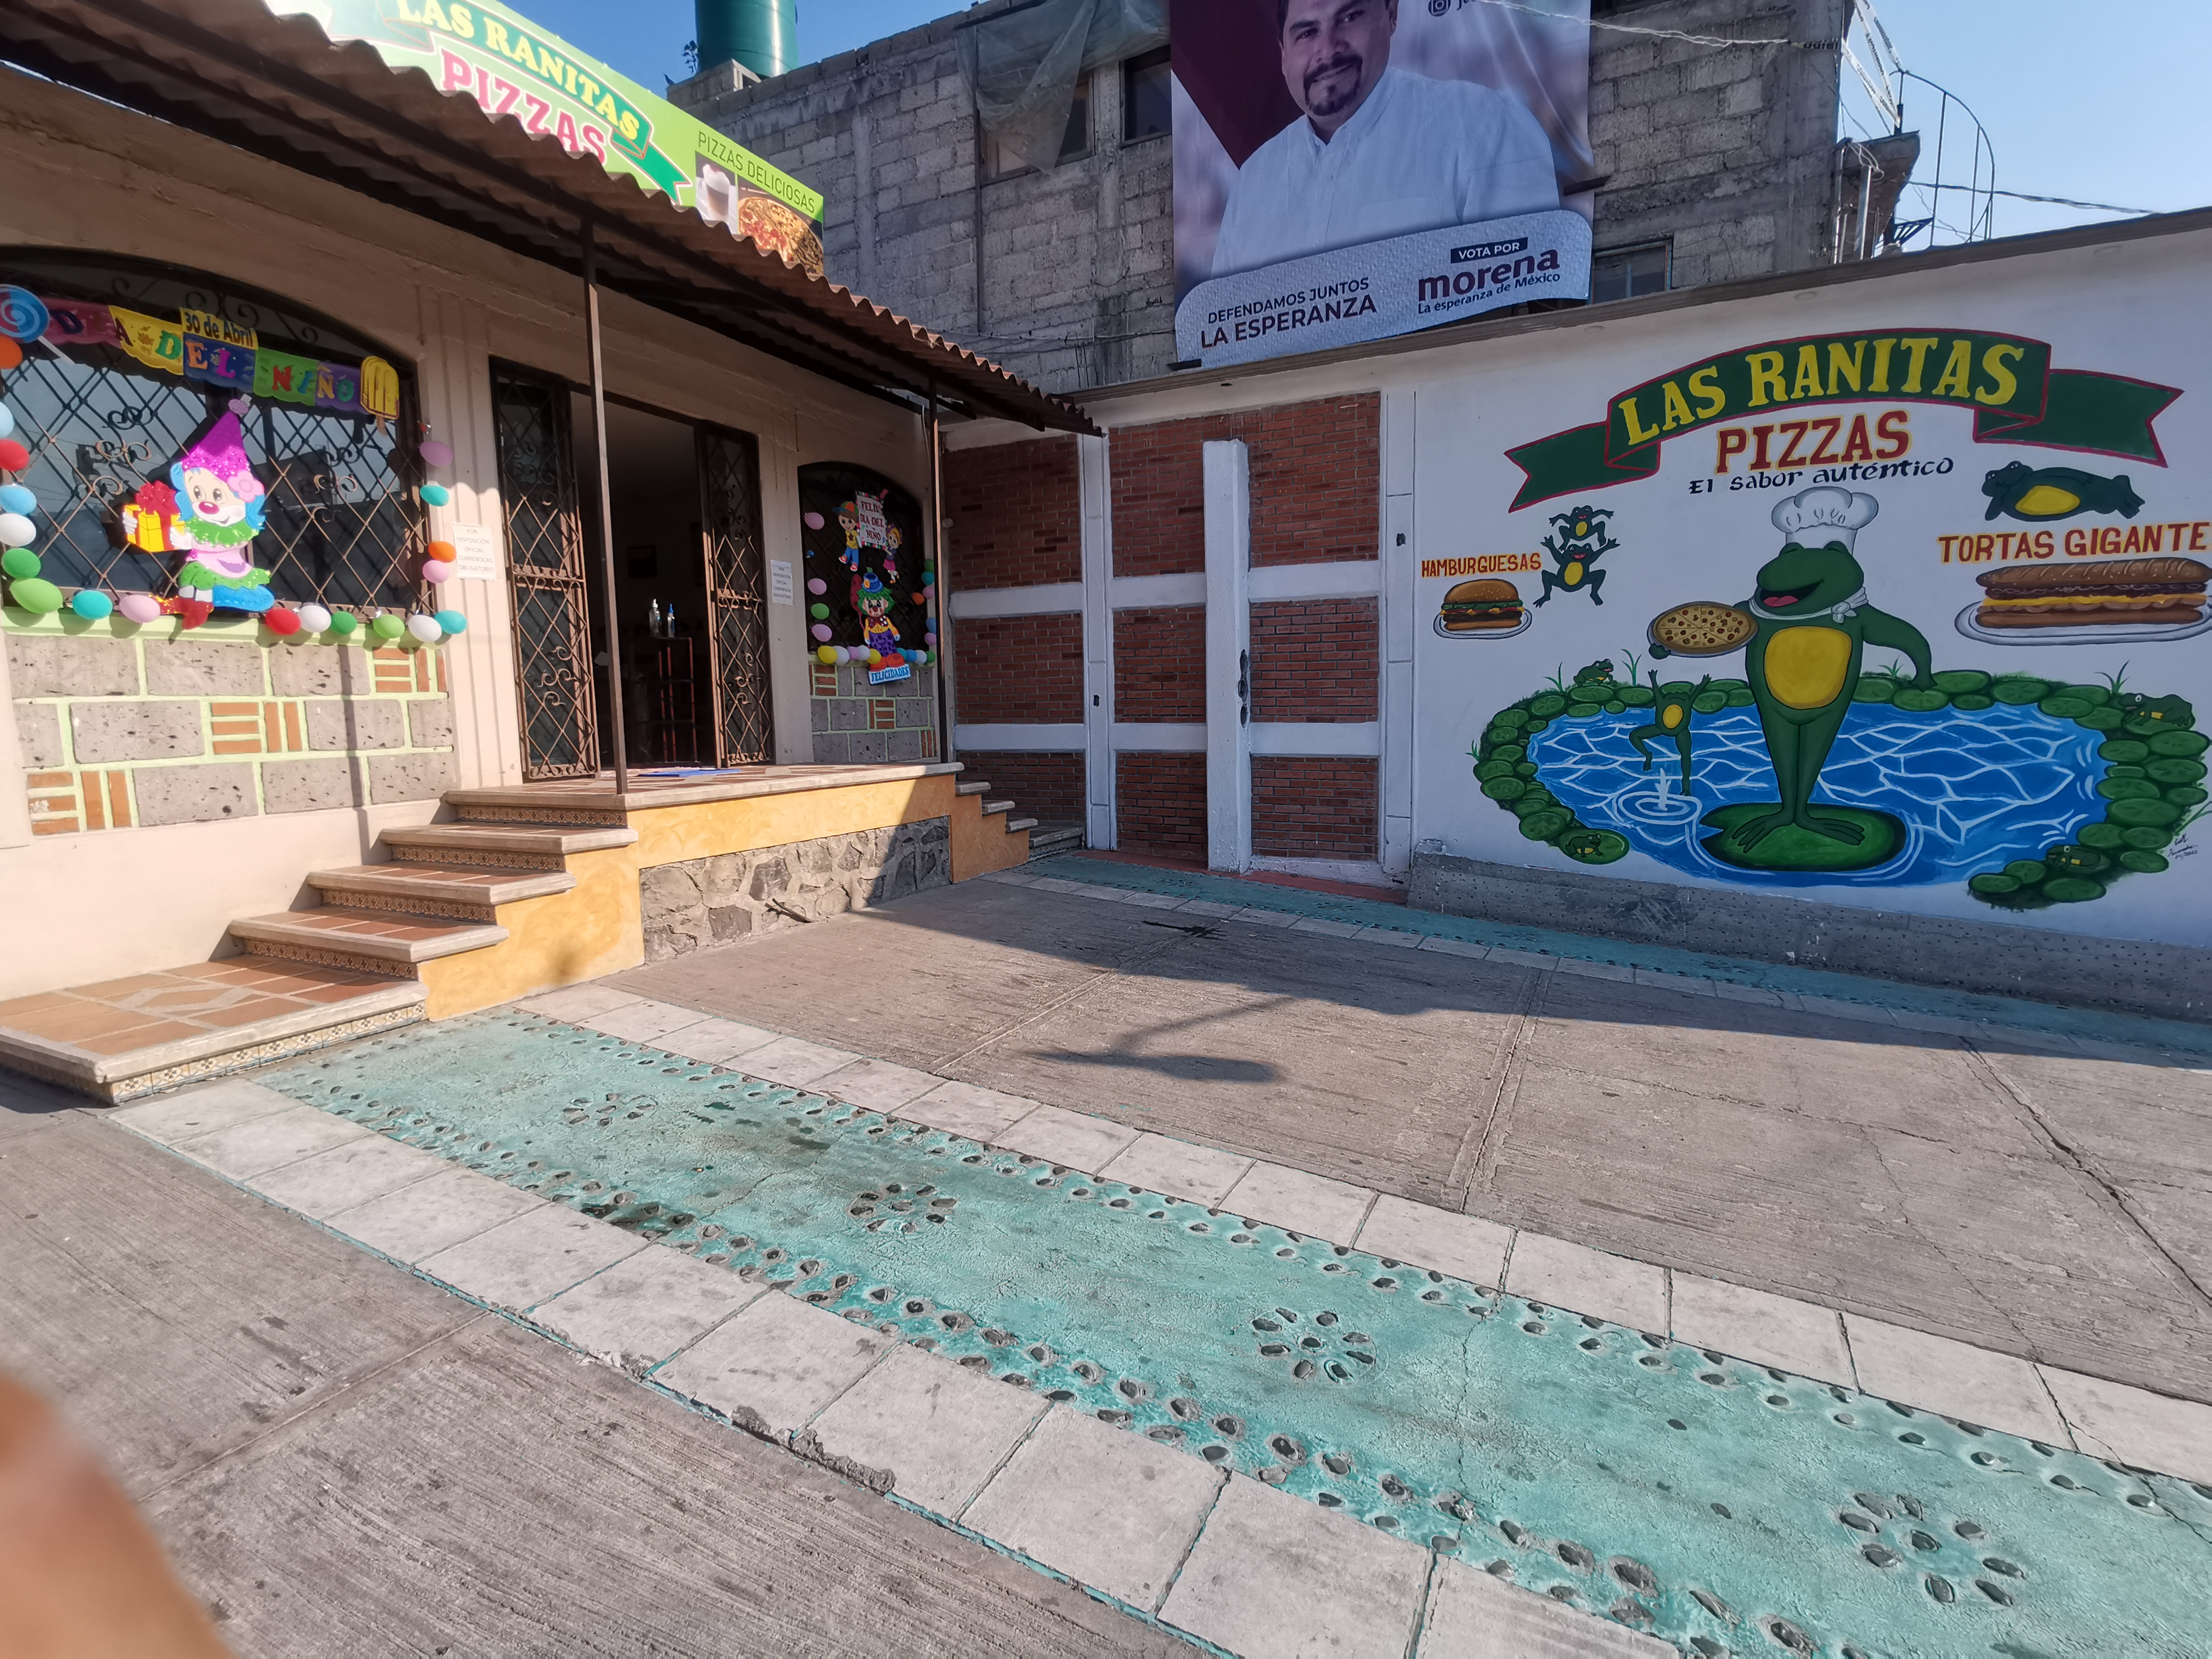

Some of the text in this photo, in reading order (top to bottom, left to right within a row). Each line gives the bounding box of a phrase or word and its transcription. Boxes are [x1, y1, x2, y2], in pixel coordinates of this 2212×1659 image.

[398, 0, 640, 140] LAS RANITAS
[439, 47, 607, 165] PIZZAS
[698, 131, 815, 213] PIZZAS DELICIOSAS
[1419, 249, 1560, 301] morena
[1458, 242, 1520, 259] VOTA POR
[1208, 277, 1370, 324] DEFENDAMOS JUNTOS
[1418, 272, 1560, 314] La esperanza de México
[185, 312, 253, 348] 30 de Abril
[1201, 294, 1377, 349] LA ESPERANZA
[155, 330, 236, 379] DEL
[272, 365, 354, 402] NIÑO
[1618, 337, 2024, 446] LAS RANITAS
[1715, 409, 1910, 474] PIZZAS
[1689, 479, 1713, 494] El
[1729, 470, 1803, 491] sabor
[1421, 553, 1542, 577] HAMBURGUESAS
[1938, 530, 2055, 563] TORTAS
[871, 666, 909, 682] FELICIDADES
